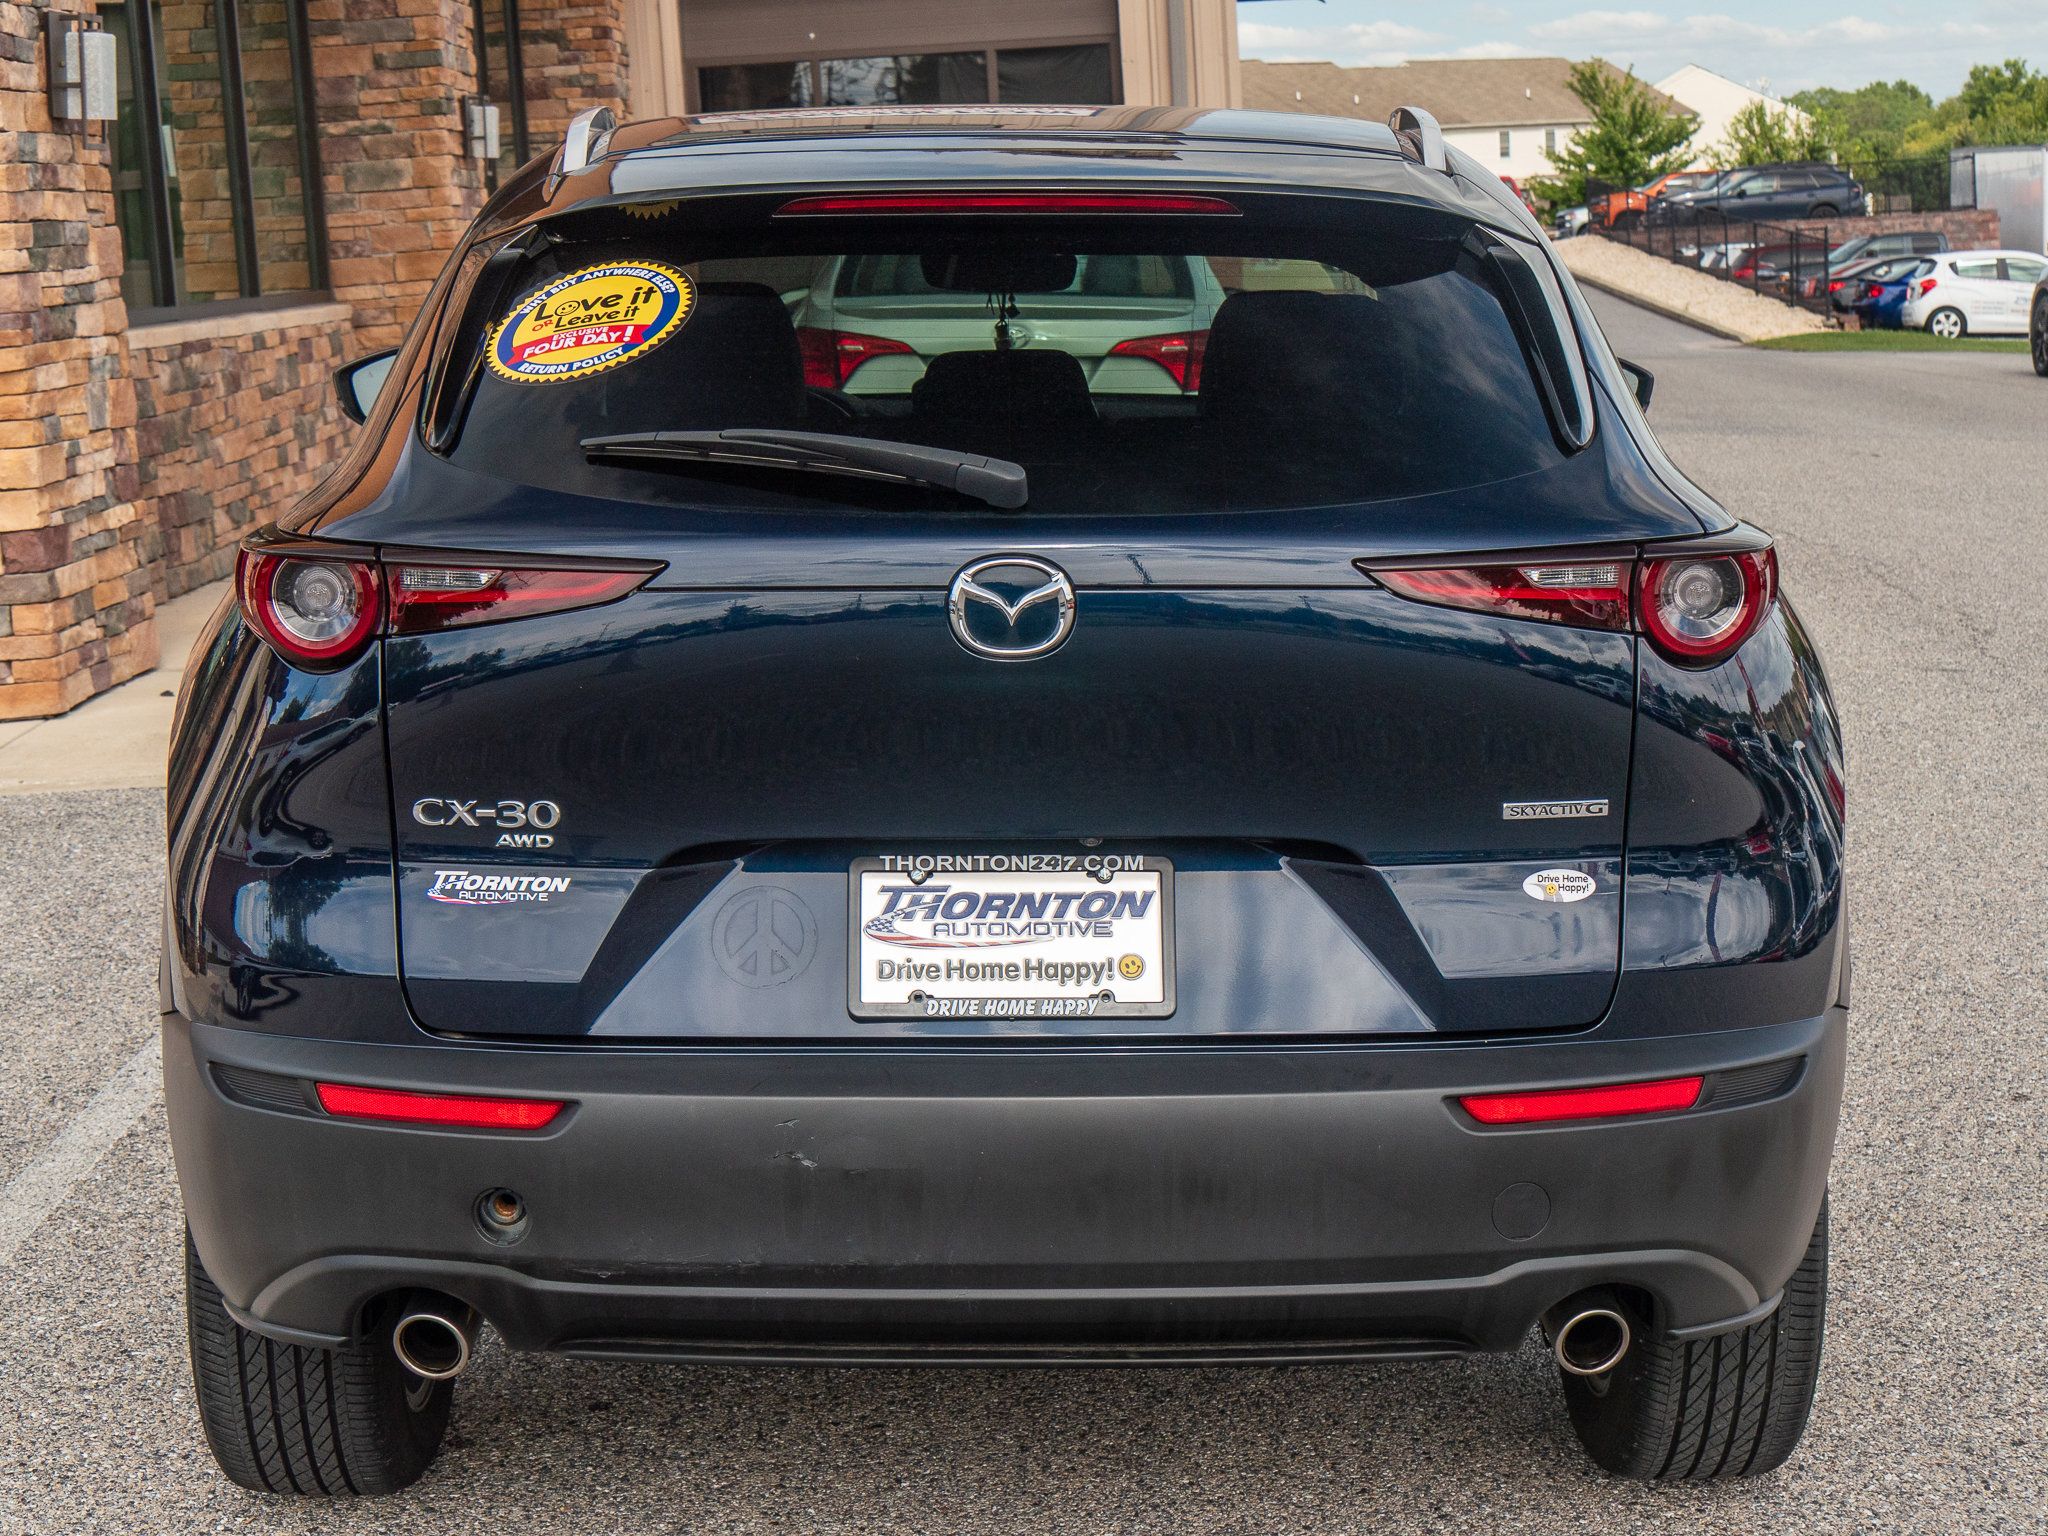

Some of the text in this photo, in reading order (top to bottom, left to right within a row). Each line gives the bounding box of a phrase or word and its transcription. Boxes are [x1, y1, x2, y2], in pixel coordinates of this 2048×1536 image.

[520, 267, 676, 314] WHY BUY ANYWHERE ELSE?
[534, 286, 657, 322] Love it
[532, 305, 640, 332] OR Leave it
[552, 326, 609, 340] EXCLUSIVE
[523, 336, 576, 359] FOUR
[518, 347, 624, 374] RETURN POLICY
[412, 798, 561, 829] CX-30
[495, 833, 554, 848] AWD
[879, 855, 1144, 871] THORNTON247.COM
[434, 870, 572, 893] THORNTON
[1537, 874, 1588, 883] Drive Home
[1558, 883, 1590, 893] Happy!
[458, 890, 549, 901] AUTOMOTIVE
[877, 884, 1156, 920] THORNTON
[933, 921, 1114, 937] AUTOMOTIVE
[877, 957, 1114, 986] Drive Home Happy!
[926, 1000, 1098, 1015] DRIVE HOME HAPPY
